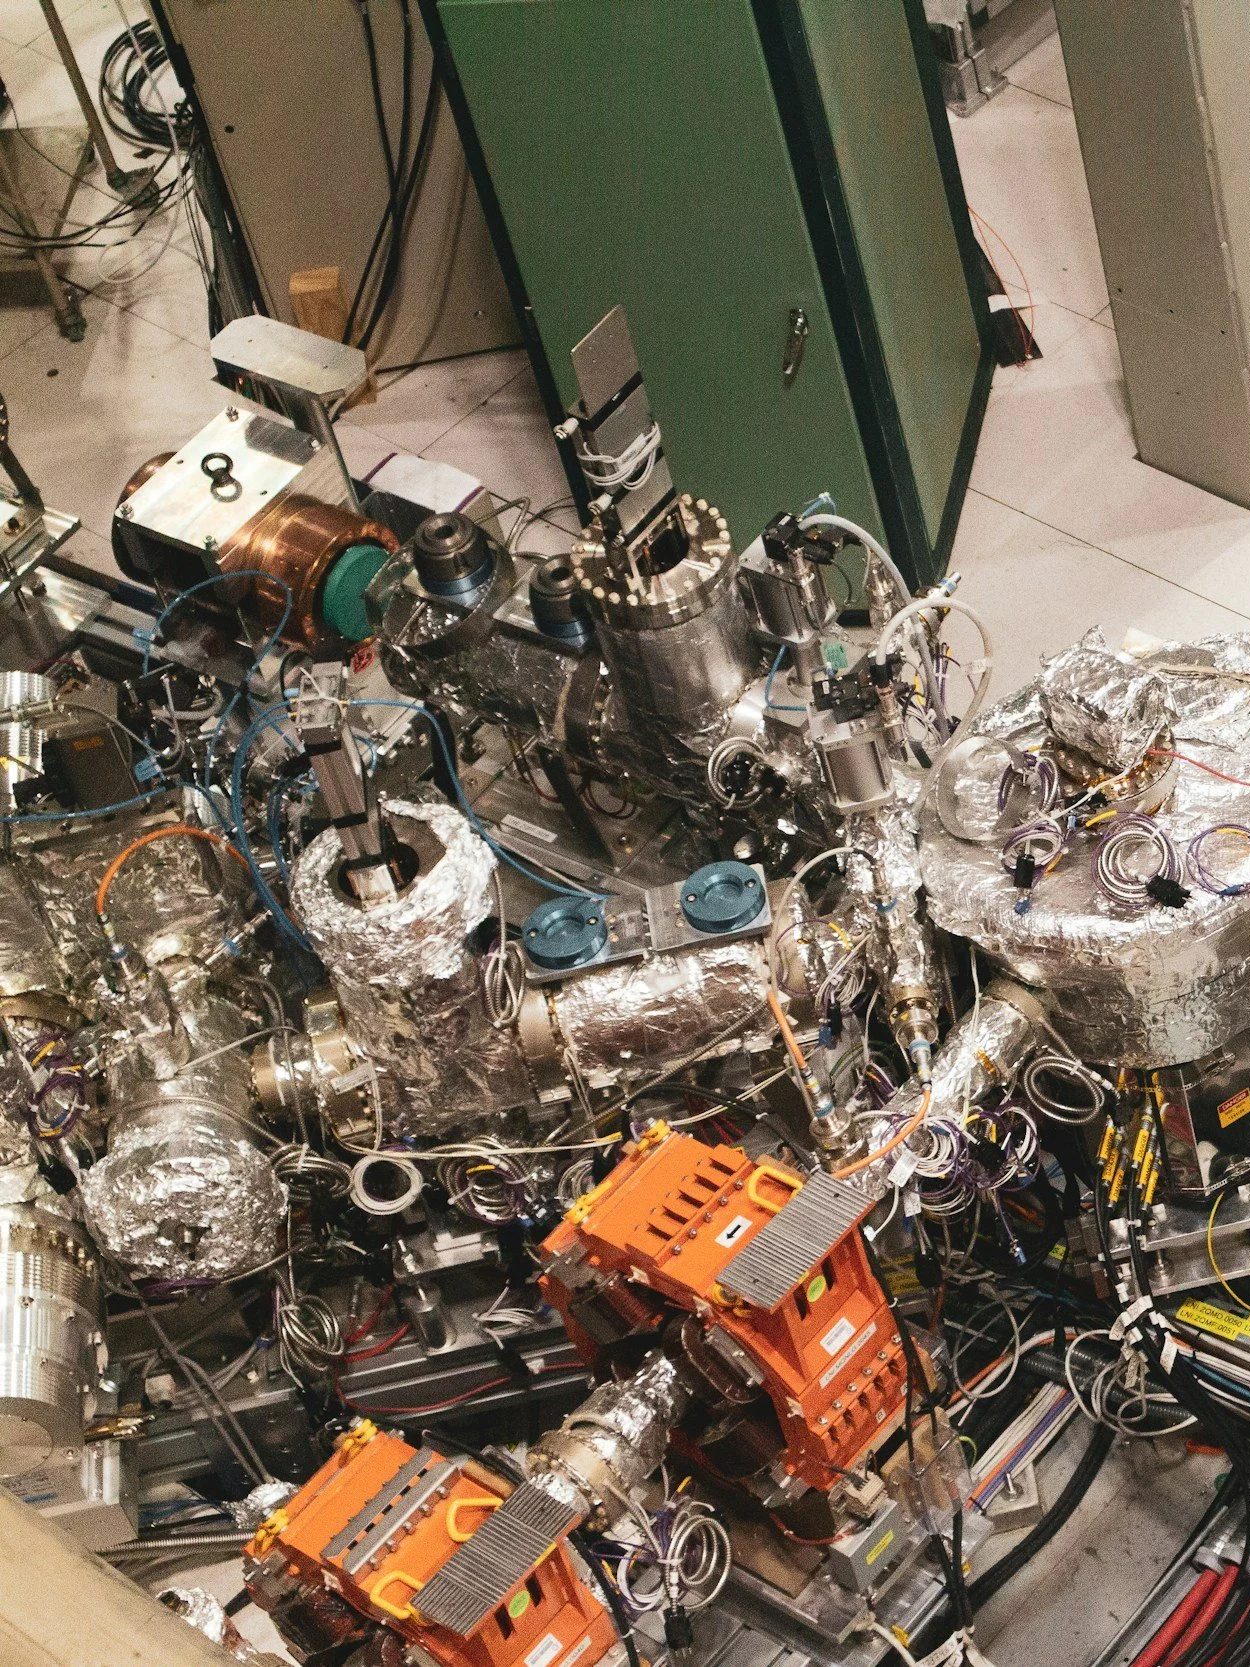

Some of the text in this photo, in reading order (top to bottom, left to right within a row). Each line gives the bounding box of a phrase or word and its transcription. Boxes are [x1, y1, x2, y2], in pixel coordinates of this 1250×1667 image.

[1223, 1092, 1247, 1111] DANGER
[1180, 1310, 1236, 1336] LNI.ZQMF.0051
[1185, 1301, 1242, 1327] LNI.ZQMD.0050
